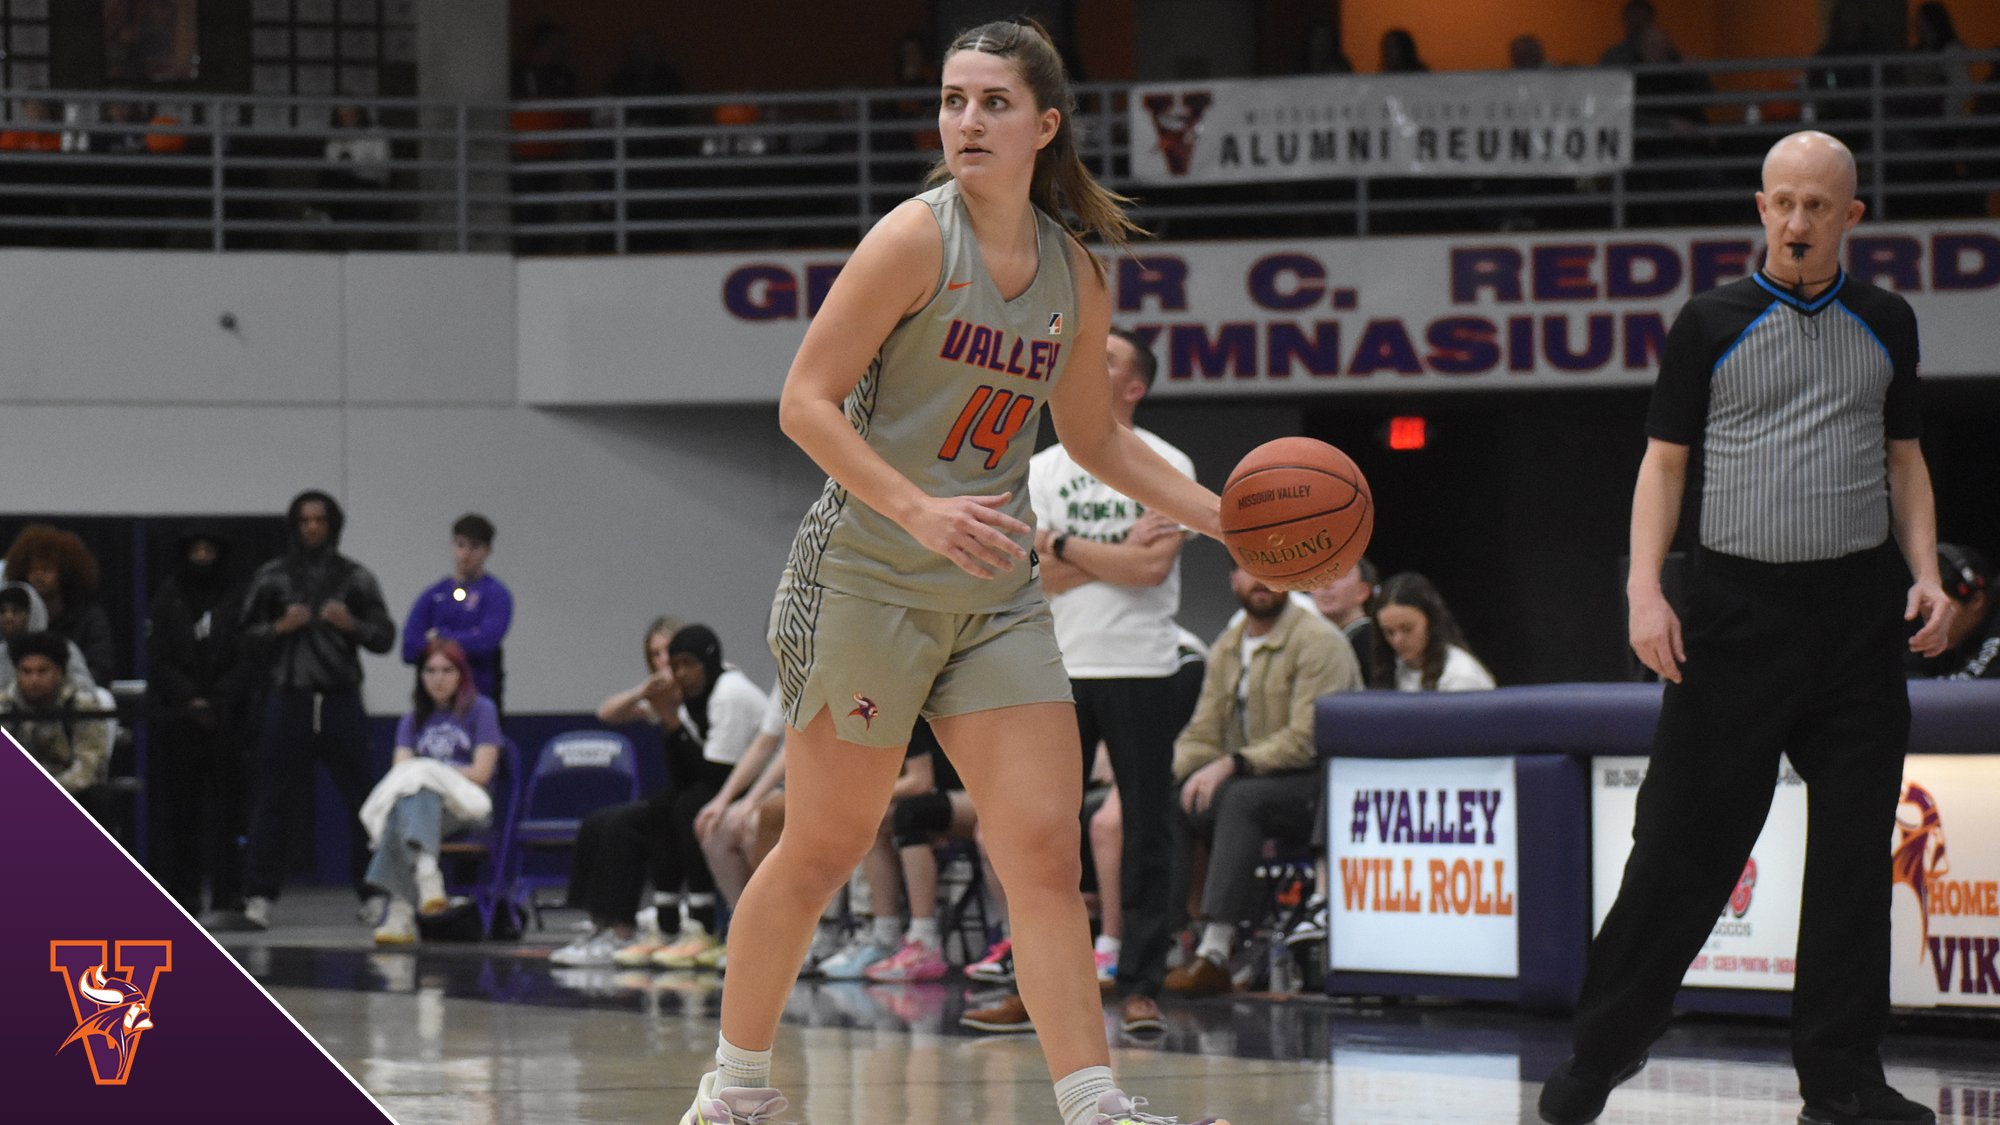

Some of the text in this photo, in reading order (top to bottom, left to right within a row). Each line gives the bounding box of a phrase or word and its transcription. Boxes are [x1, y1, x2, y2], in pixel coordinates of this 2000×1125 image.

[1219, 126, 1620, 168] ALUMNI REUNION
[1247, 252, 1358, 312] C.
[1449, 231, 2000, 304] REDFRD
[939, 319, 1061, 382] VALLEY
[937, 385, 1034, 470] 14
[1238, 485, 1311, 510] MISSOURI VALLEY
[1238, 528, 1332, 565] SPALDING
[1350, 789, 1501, 844] #VALLEY
[1340, 857, 1513, 916] WILL ROLL
[1927, 880, 1999, 916] HOME
[1927, 935, 2000, 995] VIK
